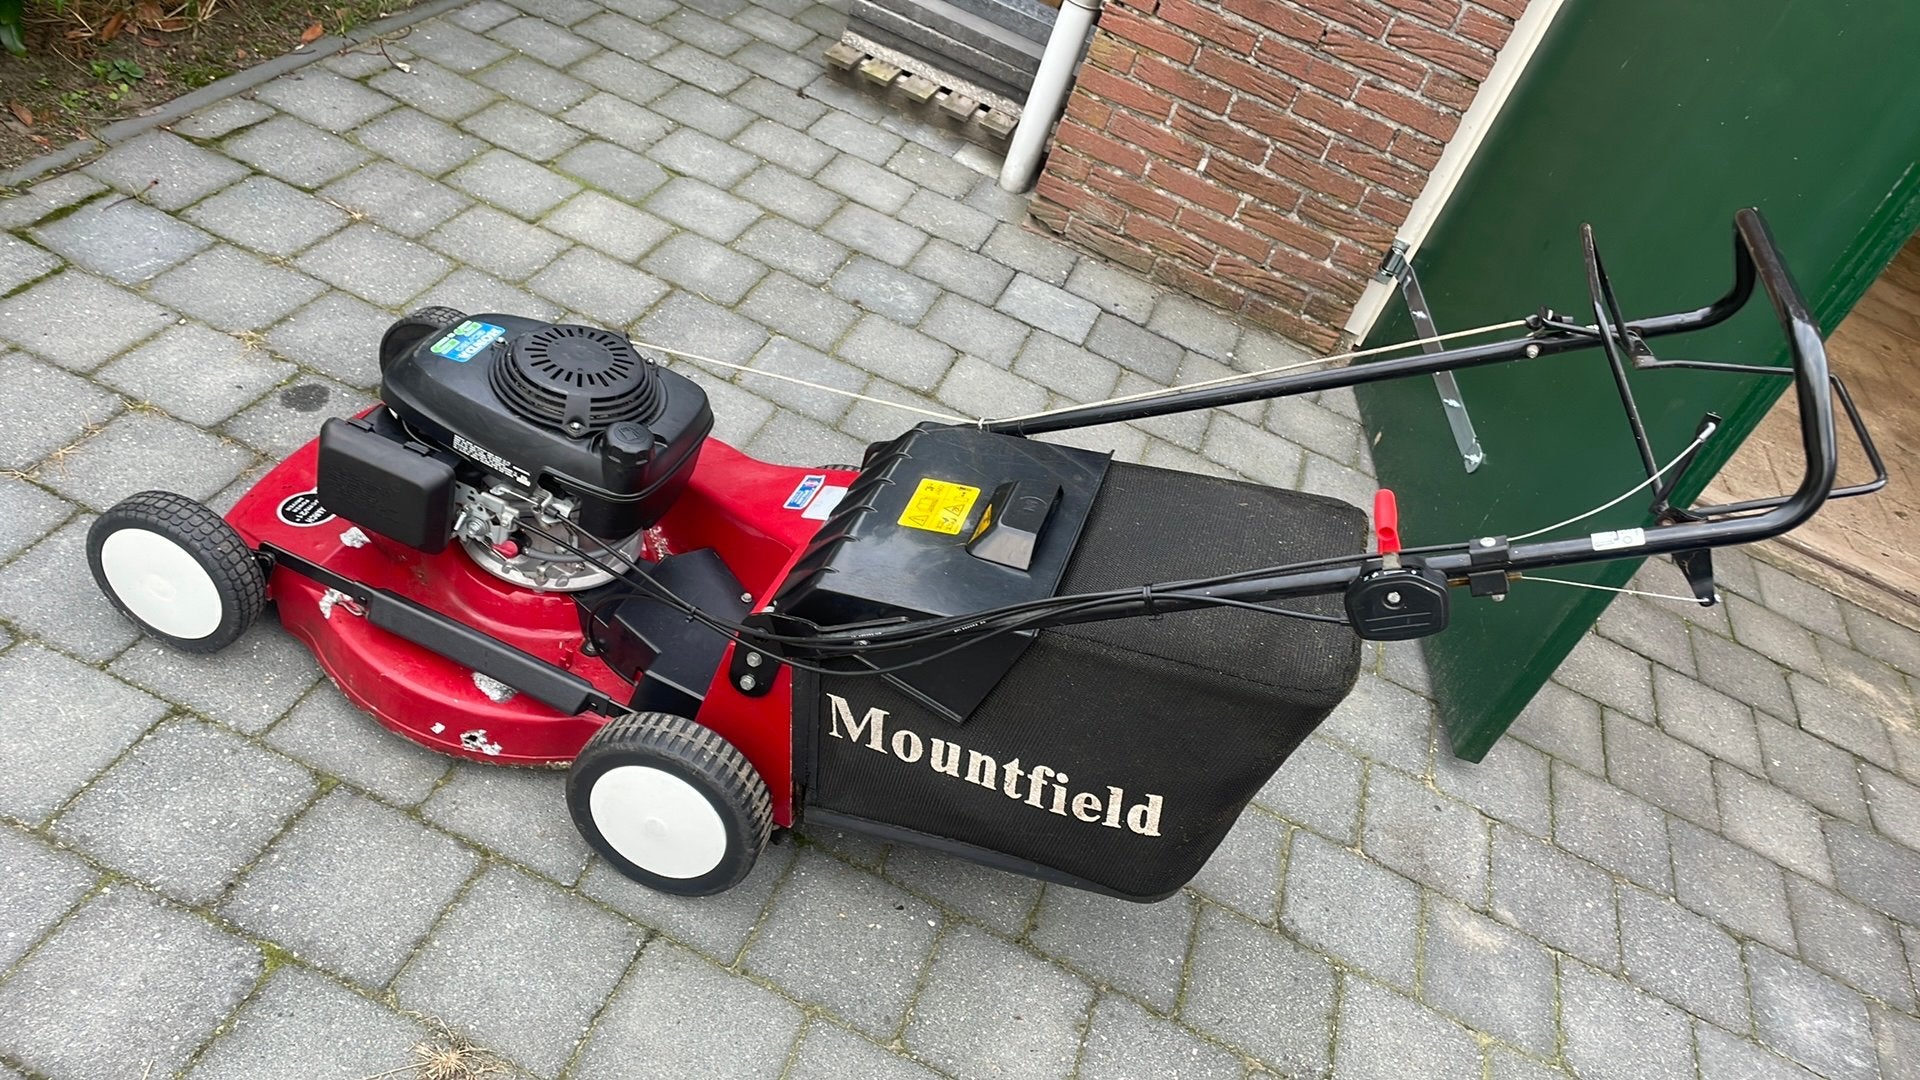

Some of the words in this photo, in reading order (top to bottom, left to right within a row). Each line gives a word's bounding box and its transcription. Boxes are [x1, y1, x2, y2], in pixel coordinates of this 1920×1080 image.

[430, 320, 483, 354] 5.5
[457, 328, 501, 359] HONDA
[826, 692, 1164, 836] Mountfield
